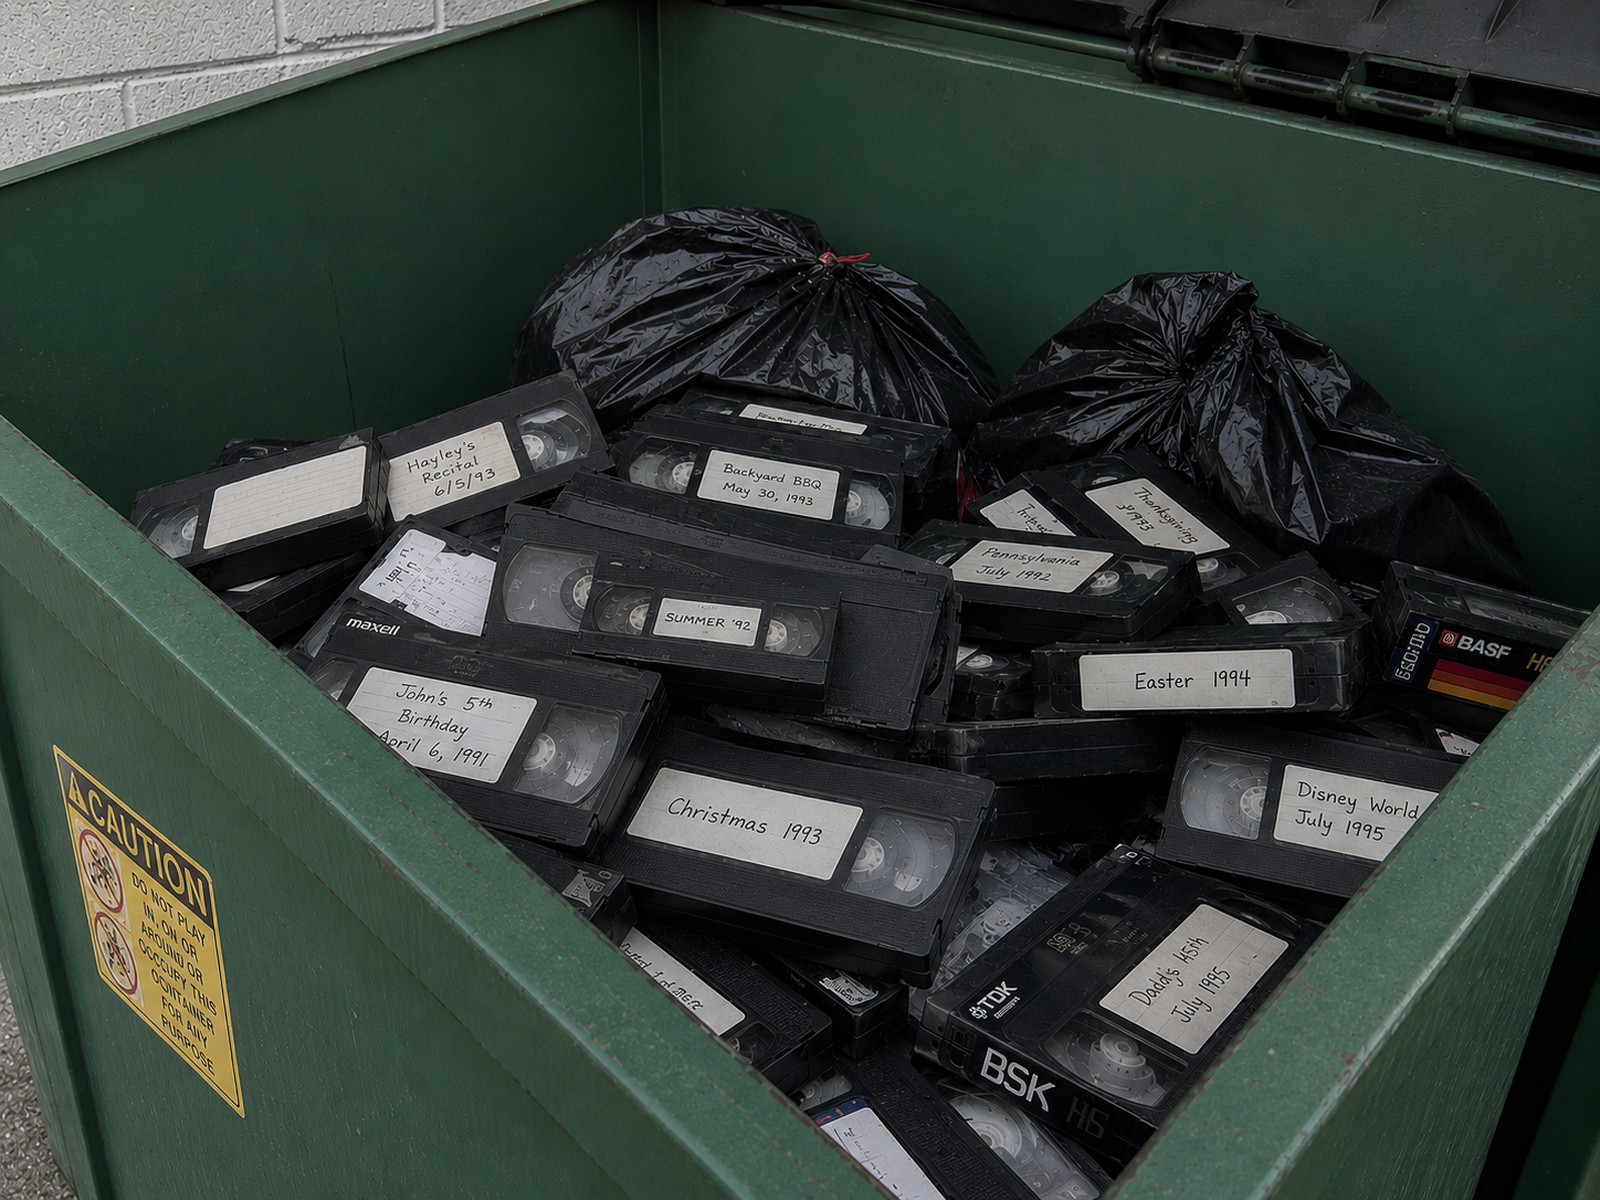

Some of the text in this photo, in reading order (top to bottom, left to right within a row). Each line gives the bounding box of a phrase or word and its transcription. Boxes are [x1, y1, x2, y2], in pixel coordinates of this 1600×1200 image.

[407, 441, 476, 473] Hayley's
[422, 456, 479, 484] Recital
[434, 468, 496, 496] 6/5/93
[723, 462, 822, 490] Backyard BBQ
[723, 482, 814, 506] May 30, 1993
[981, 547, 1081, 566] Pennsylvania
[976, 565, 1052, 582] July 1992
[346, 618, 401, 636] maxell
[664, 612, 751, 631] SUMMER '92
[1457, 635, 1513, 660] BASF
[1134, 669, 1251, 690] Easter 1994
[395, 683, 494, 711] John's 5th
[397, 708, 470, 742] Birthday
[428, 742, 444, 763] 6,
[453, 747, 490, 768] 1991
[1297, 781, 1420, 820] Disney World
[667, 797, 823, 845] Christmas 1993
[1295, 809, 1386, 841] July 1995
[87, 789, 208, 917] CAUTION
[131, 872, 206, 948] DO NOT PLAY
[161, 919, 179, 945] ON
[181, 937, 199, 963] OR
[186, 961, 204, 986] OR
[190, 982, 218, 1017] THIS
[976, 980, 1018, 1009] TDK
[1170, 965, 1231, 1024] July 1995
[161, 994, 184, 1027] FOR
[160, 1013, 216, 1077] PURPOSE
[980, 1047, 1056, 1112] BSK
